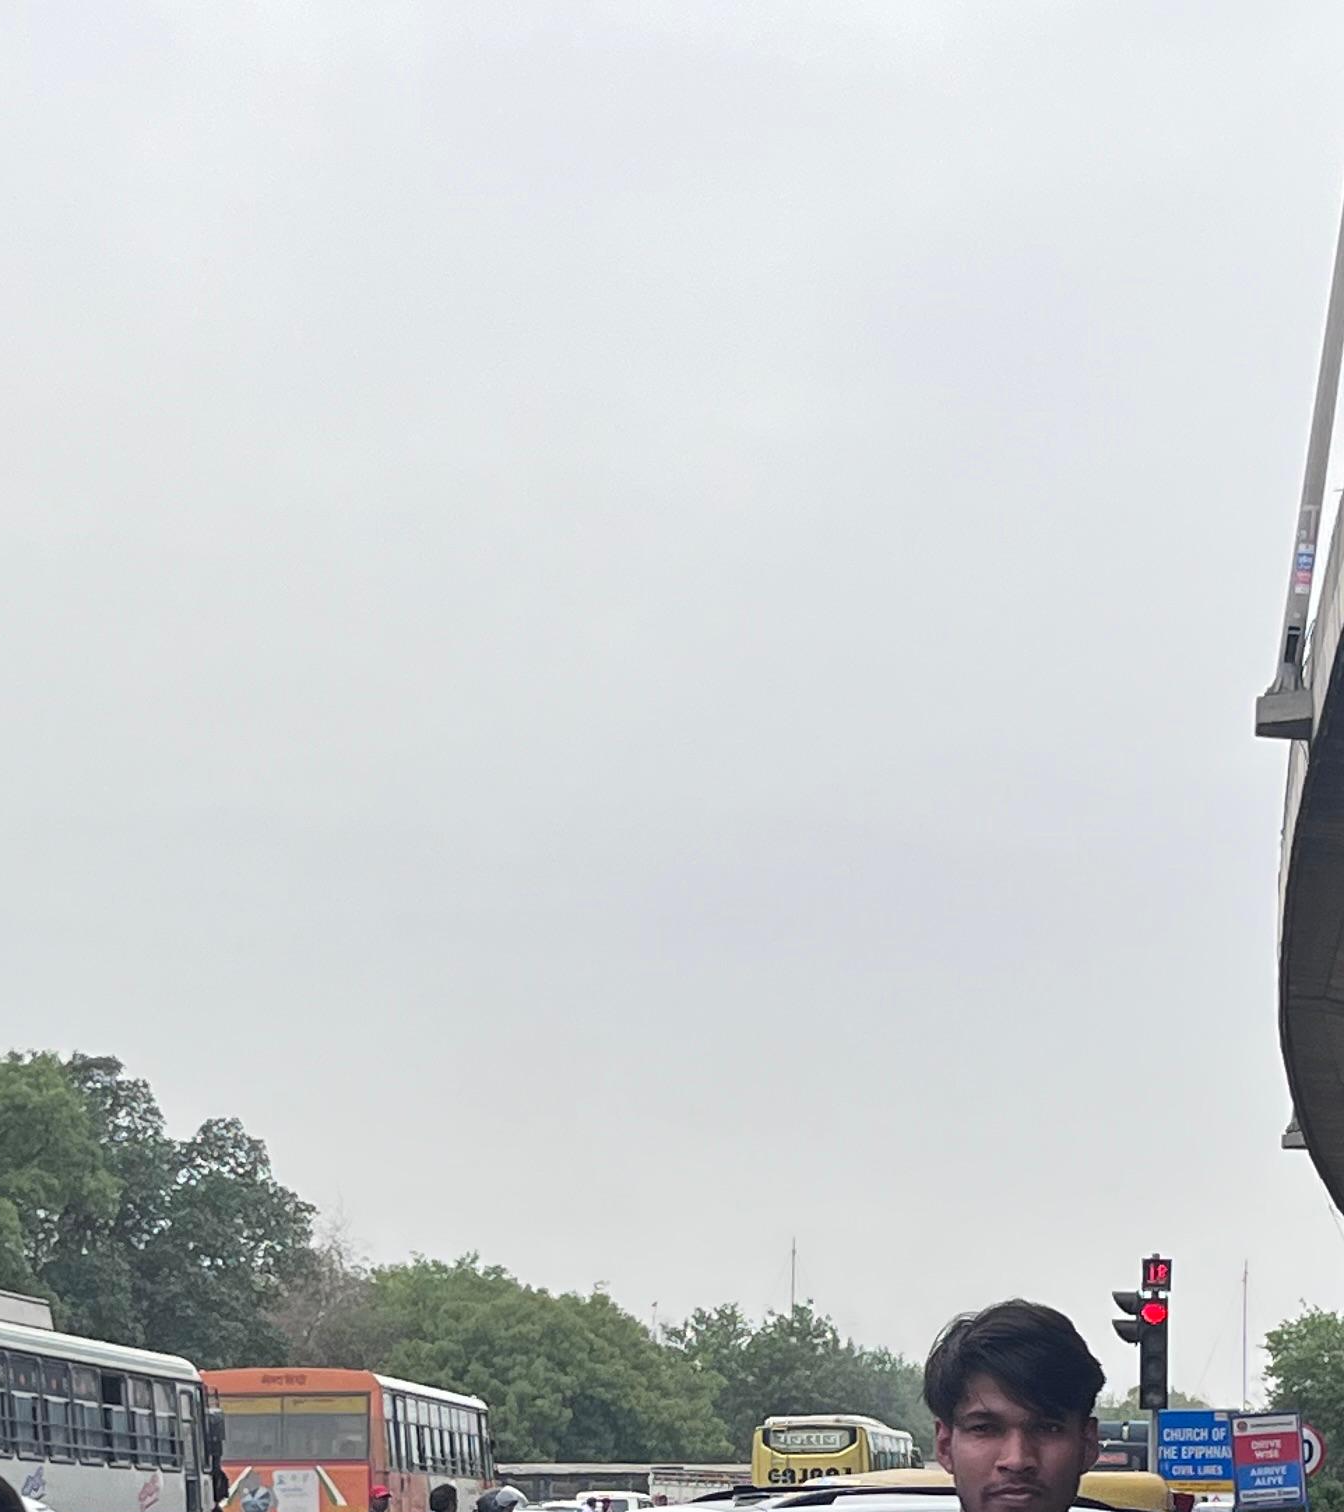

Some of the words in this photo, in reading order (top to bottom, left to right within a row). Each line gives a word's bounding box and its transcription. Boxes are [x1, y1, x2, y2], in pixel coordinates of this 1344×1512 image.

[1163, 1428, 1208, 1441] CHURCH
[1212, 1428, 1227, 1441] OF
[1158, 1446, 1179, 1459] THE
[1172, 1465, 1194, 1476] CIVIL
[1197, 1465, 1223, 1476] LINES
[1250, 1465, 1287, 1476] ARRIVE
